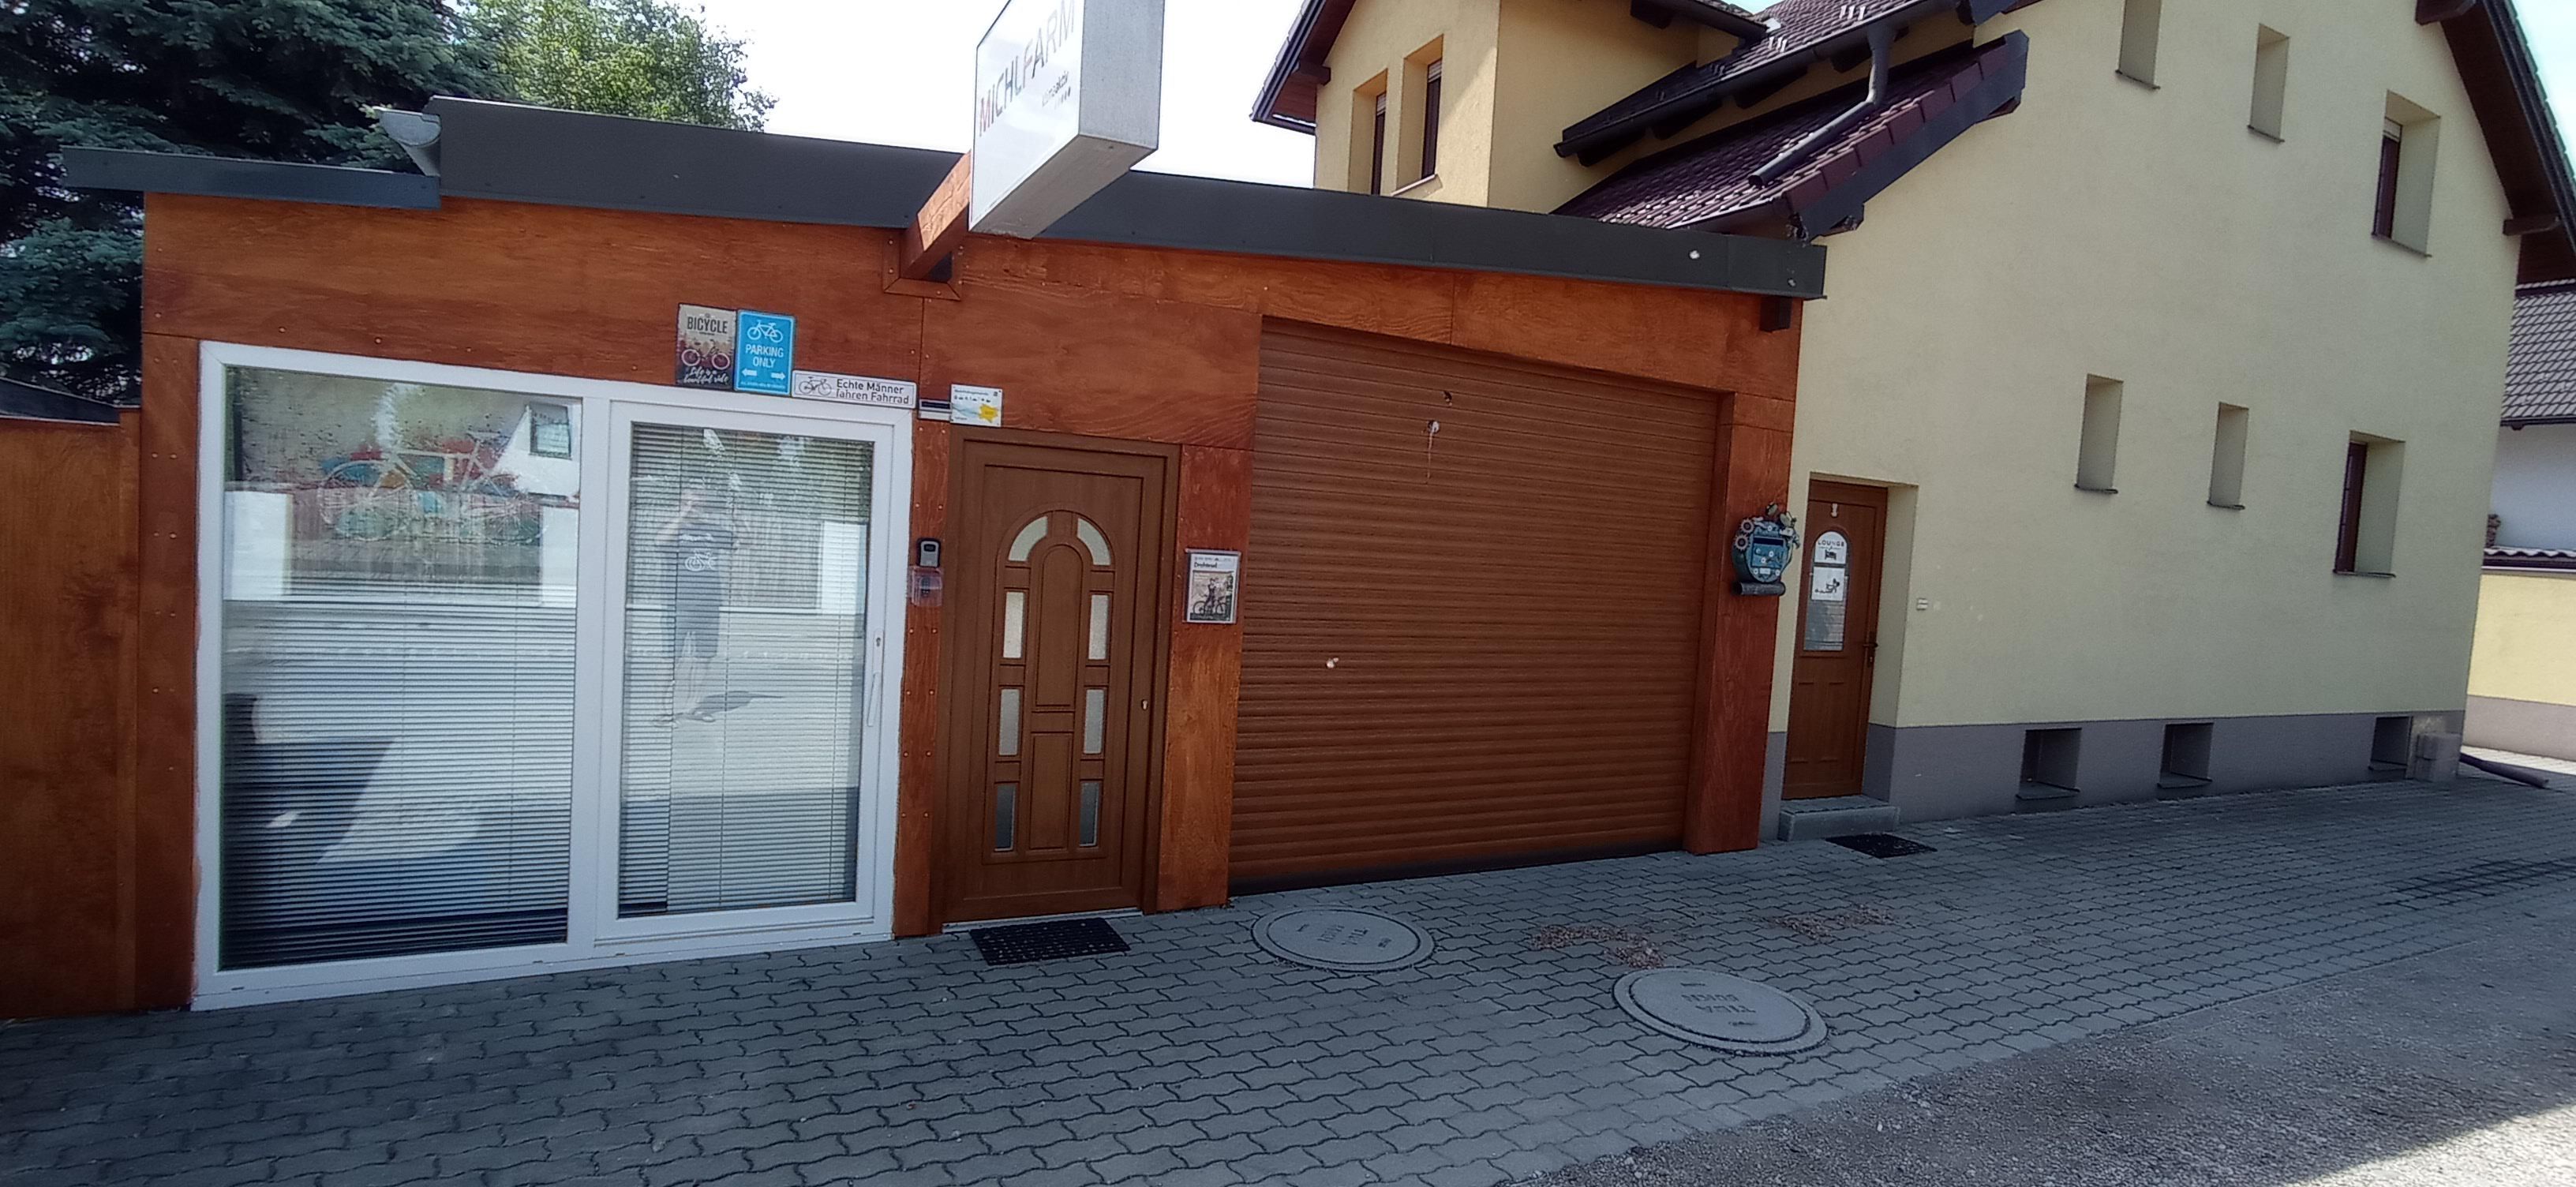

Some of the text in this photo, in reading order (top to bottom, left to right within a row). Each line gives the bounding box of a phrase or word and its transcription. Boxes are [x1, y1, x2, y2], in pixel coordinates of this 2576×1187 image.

[687, 316, 728, 335] BICYCLE
[745, 344, 784, 358] PARKING
[752, 356, 776, 368] ONLY
[837, 378, 904, 395] Echte Männer
[836, 389, 909, 404] fahren Fahrrad
